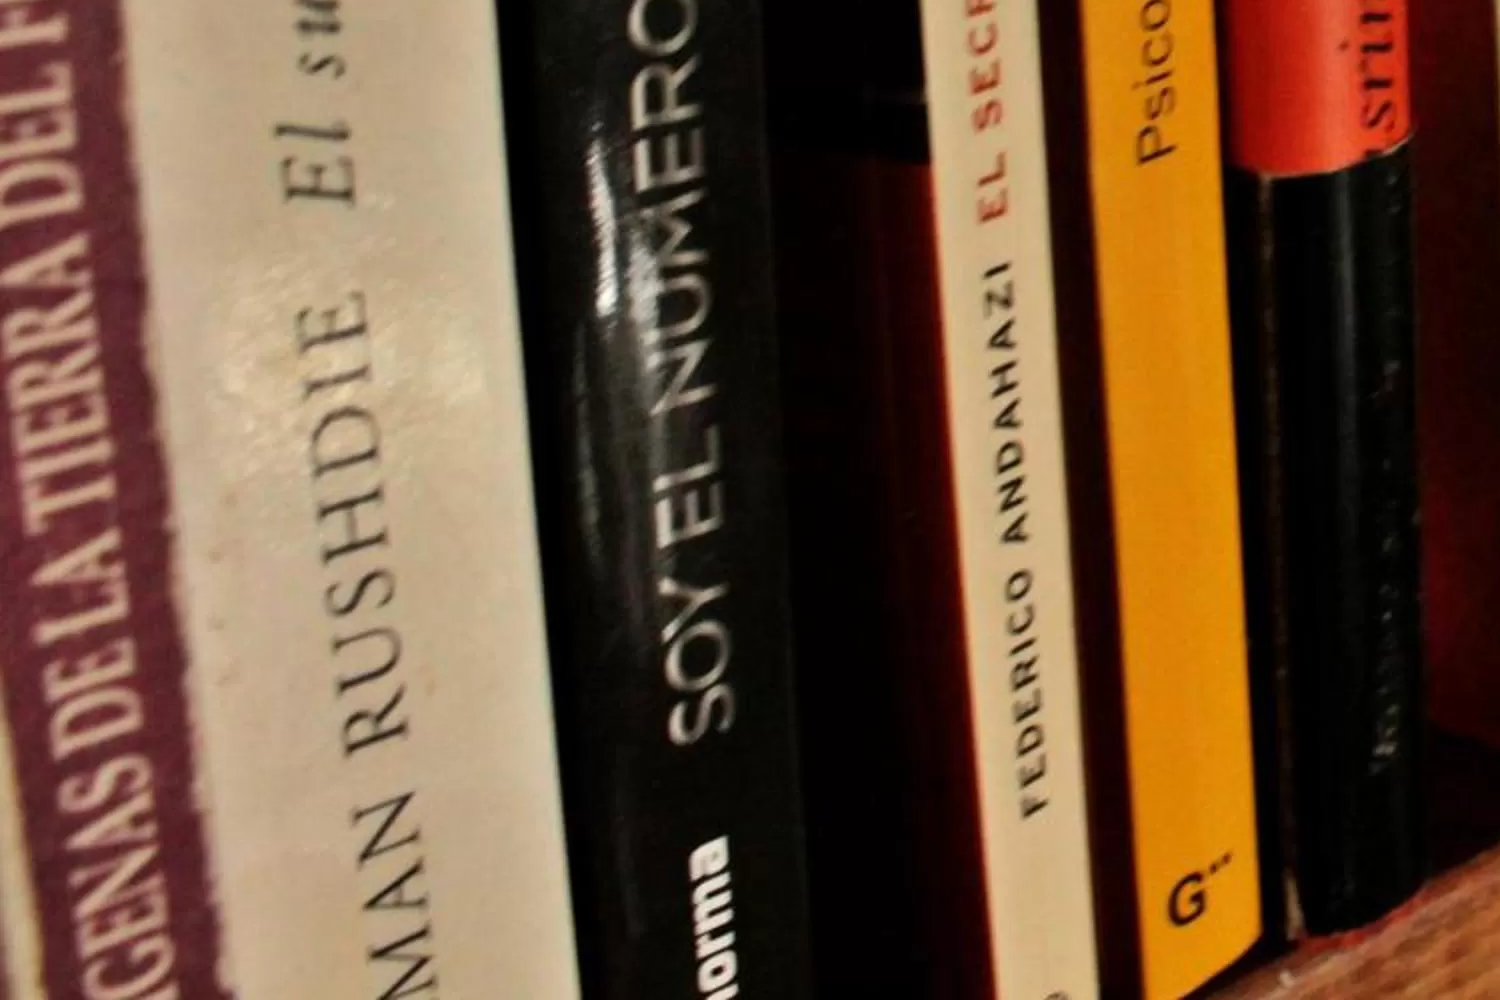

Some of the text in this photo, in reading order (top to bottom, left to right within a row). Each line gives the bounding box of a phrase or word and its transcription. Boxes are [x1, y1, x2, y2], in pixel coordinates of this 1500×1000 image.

[0, 60, 84, 229] DEL
[273, 119, 356, 209] El
[977, 151, 1011, 226] EL
[5, 233, 118, 536] TIERRA
[981, 261, 1031, 545] ANDAHAZI
[295, 290, 409, 757] RUSHDIE
[651, 421, 726, 547] EL
[32, 527, 131, 648] LA
[656, 577, 734, 747] SOY
[45, 637, 145, 763] DE
[1002, 568, 1048, 820] FEDERICO
